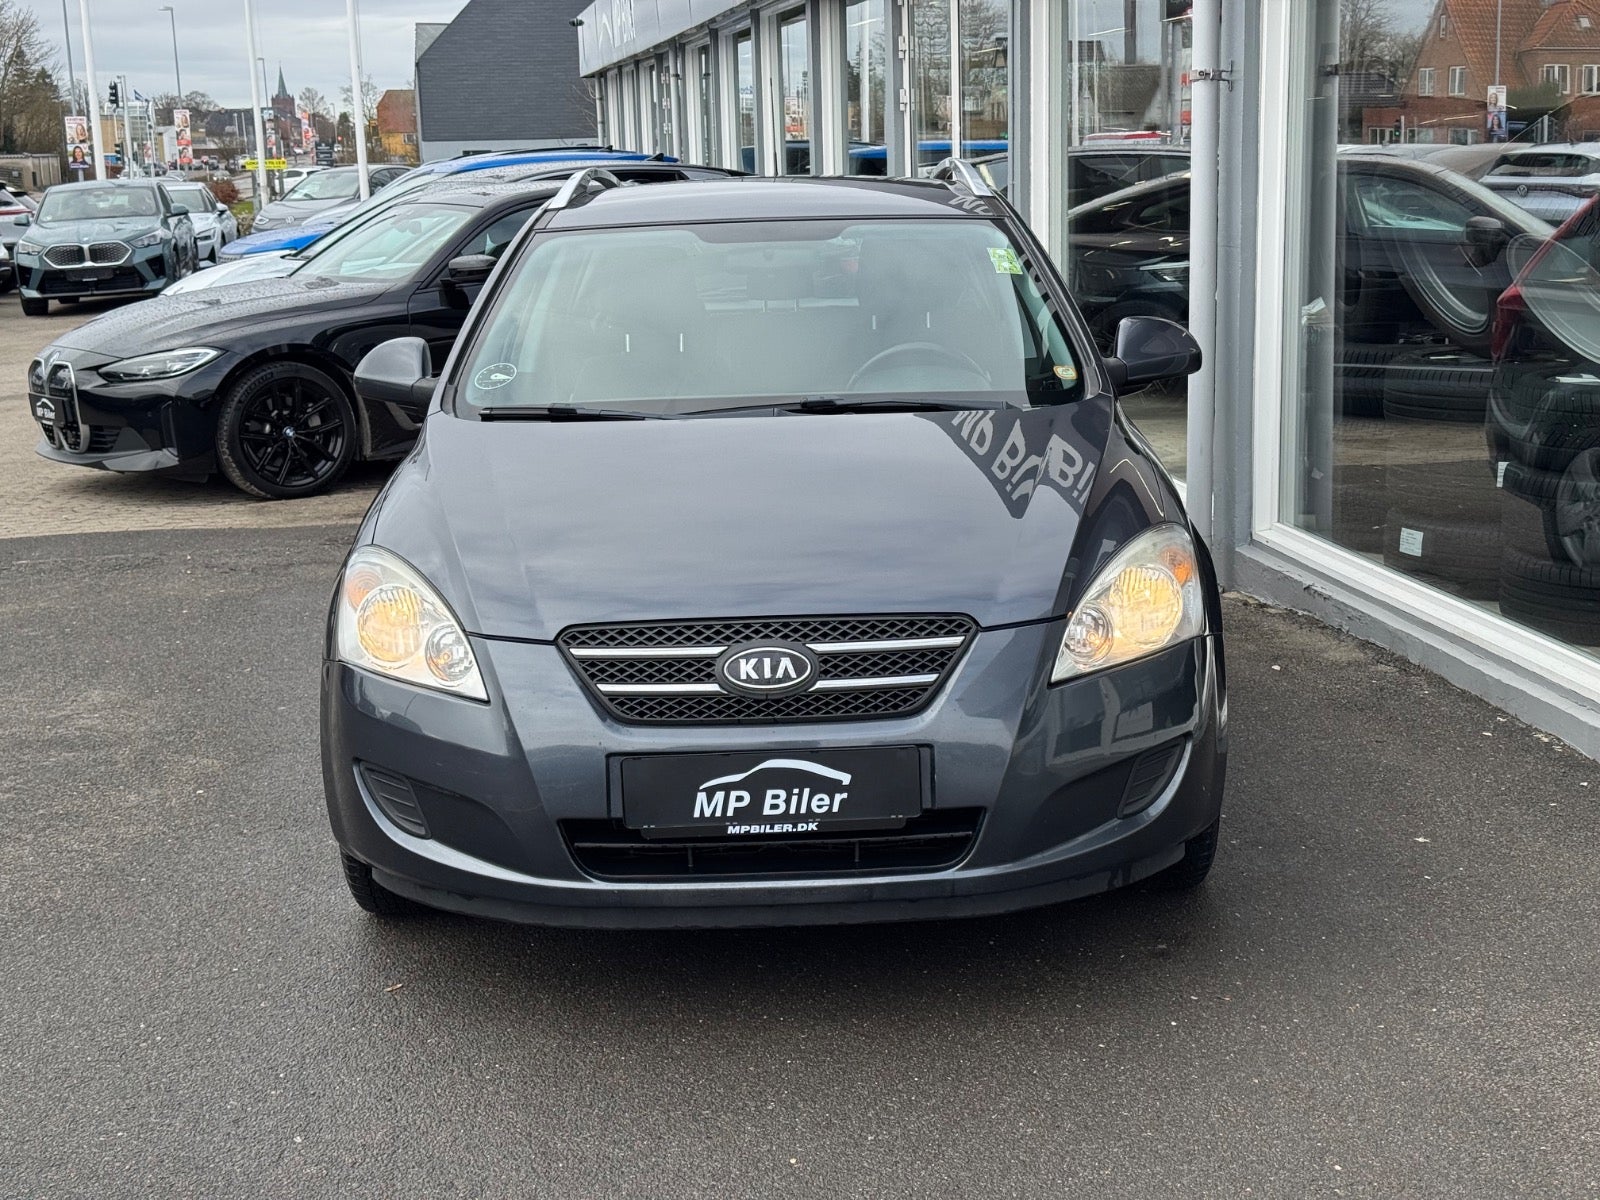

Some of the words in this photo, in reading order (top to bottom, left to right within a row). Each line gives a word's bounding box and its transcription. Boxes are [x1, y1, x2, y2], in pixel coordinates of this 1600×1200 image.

[738, 657, 798, 680] KIA
[693, 790, 751, 818] MP
[762, 788, 848, 815] Biler
[727, 822, 818, 835] MPBILER.DK
